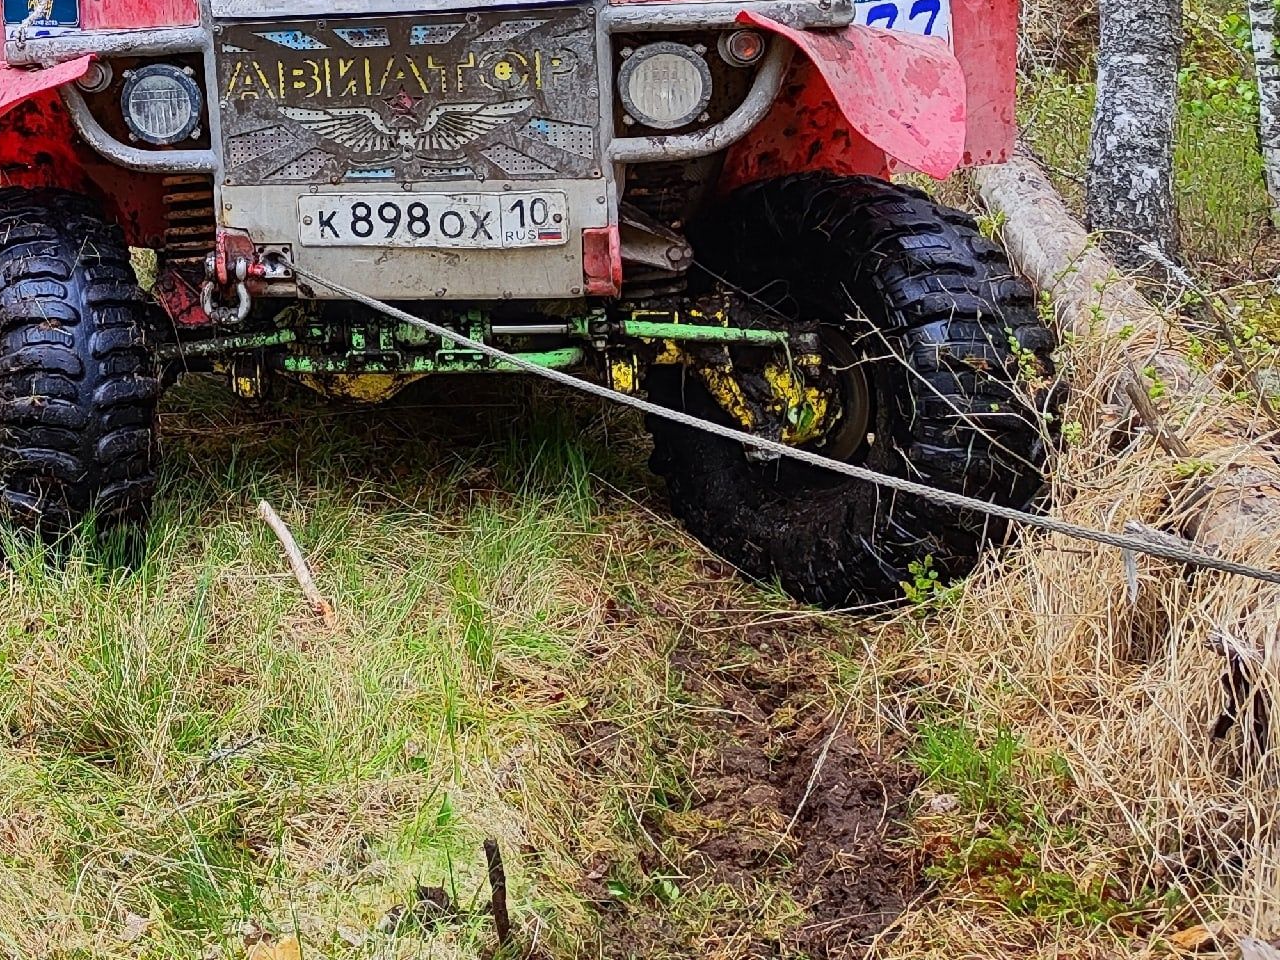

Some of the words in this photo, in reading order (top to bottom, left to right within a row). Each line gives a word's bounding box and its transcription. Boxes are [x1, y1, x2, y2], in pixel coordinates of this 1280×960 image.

[225, 47, 578, 100] АВИАТОР
[508, 197, 549, 228] 10
[505, 230, 537, 242] RUS
